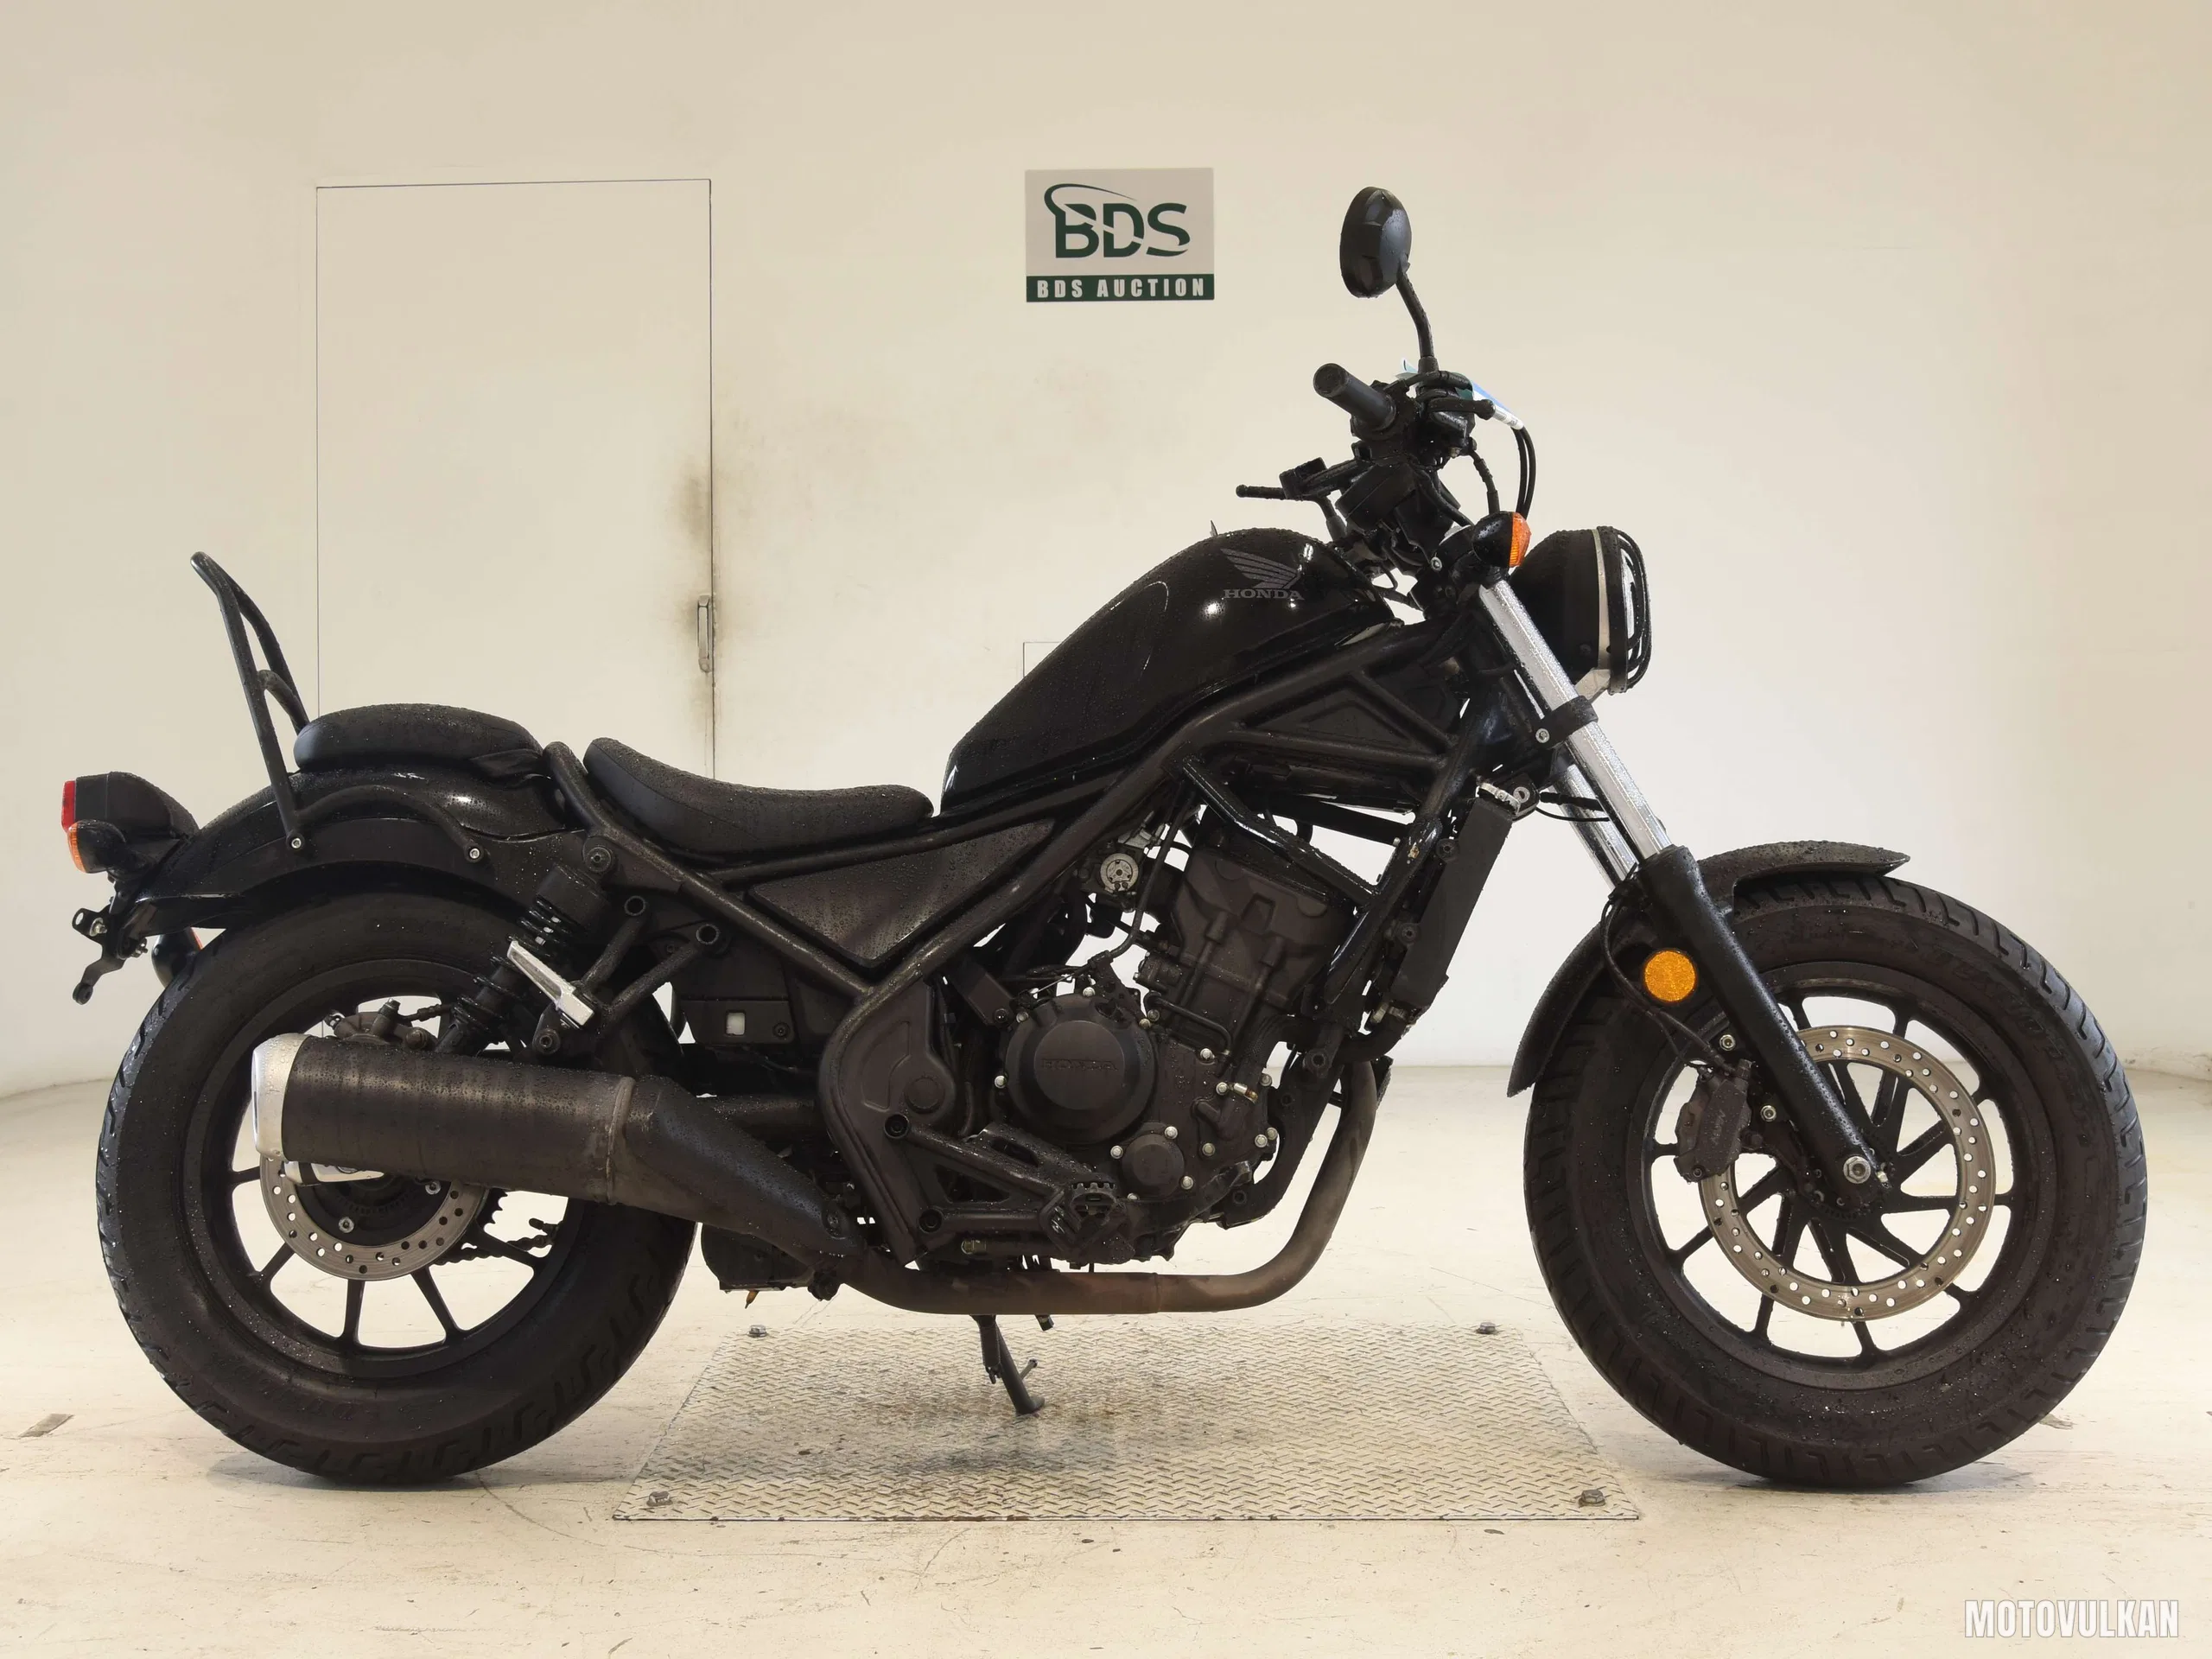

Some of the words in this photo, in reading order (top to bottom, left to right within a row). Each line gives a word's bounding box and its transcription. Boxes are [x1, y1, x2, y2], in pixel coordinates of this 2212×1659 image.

[1044, 183, 1191, 258] BDS
[1037, 280, 1083, 298] BDS
[1096, 277, 1204, 297] AUCTION
[1223, 588, 1305, 600] HONDA
